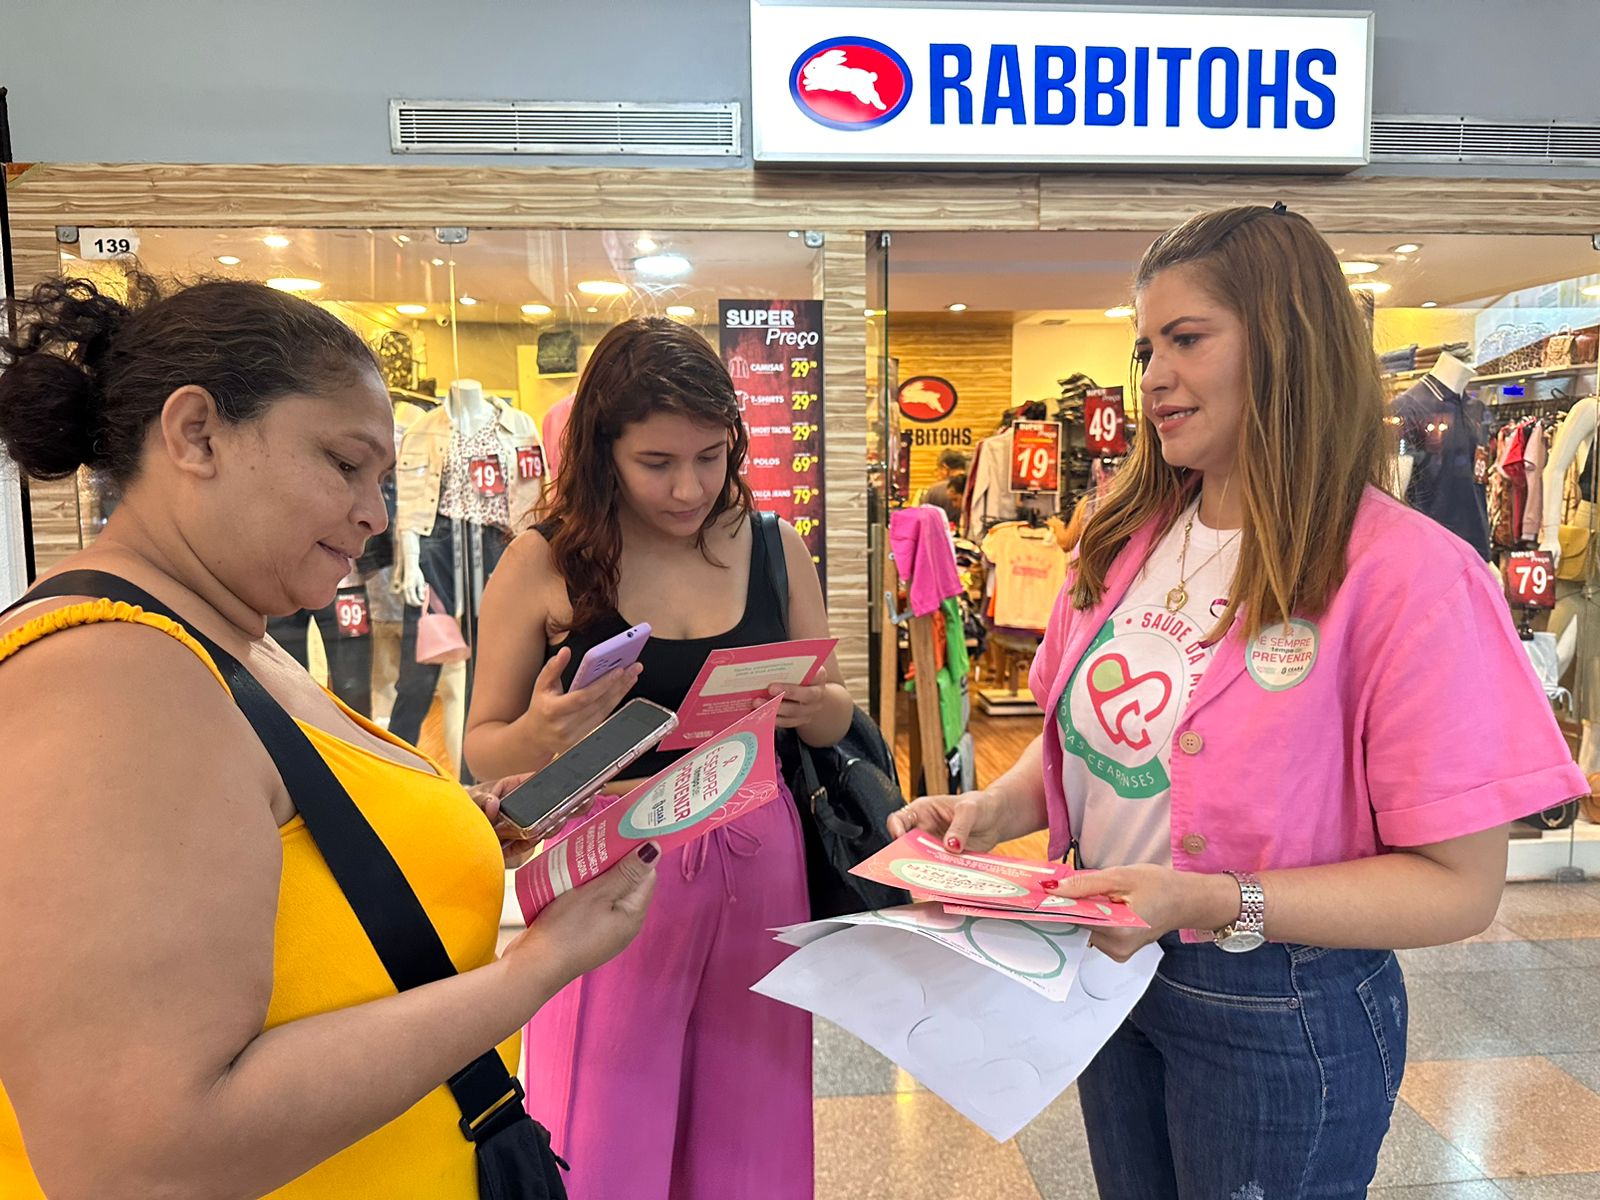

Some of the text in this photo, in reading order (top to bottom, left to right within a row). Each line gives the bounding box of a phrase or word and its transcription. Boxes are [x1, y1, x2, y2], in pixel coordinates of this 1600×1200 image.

[929, 43, 1337, 129] RABBITOHS
[95, 239, 130, 253] 139
[726, 309, 795, 326] SUPER
[766, 328, 819, 349] Preço
[750, 363, 784, 371] CAMISAS
[520, 456, 542, 478] 179
[1141, 612, 1206, 665] SAÚDE DA
[1260, 635, 1312, 648] É SEMPRE
[1252, 651, 1313, 663] PREVENIR
[701, 753, 718, 802] SEMPRE
[672, 761, 694, 823] PREVENIR
